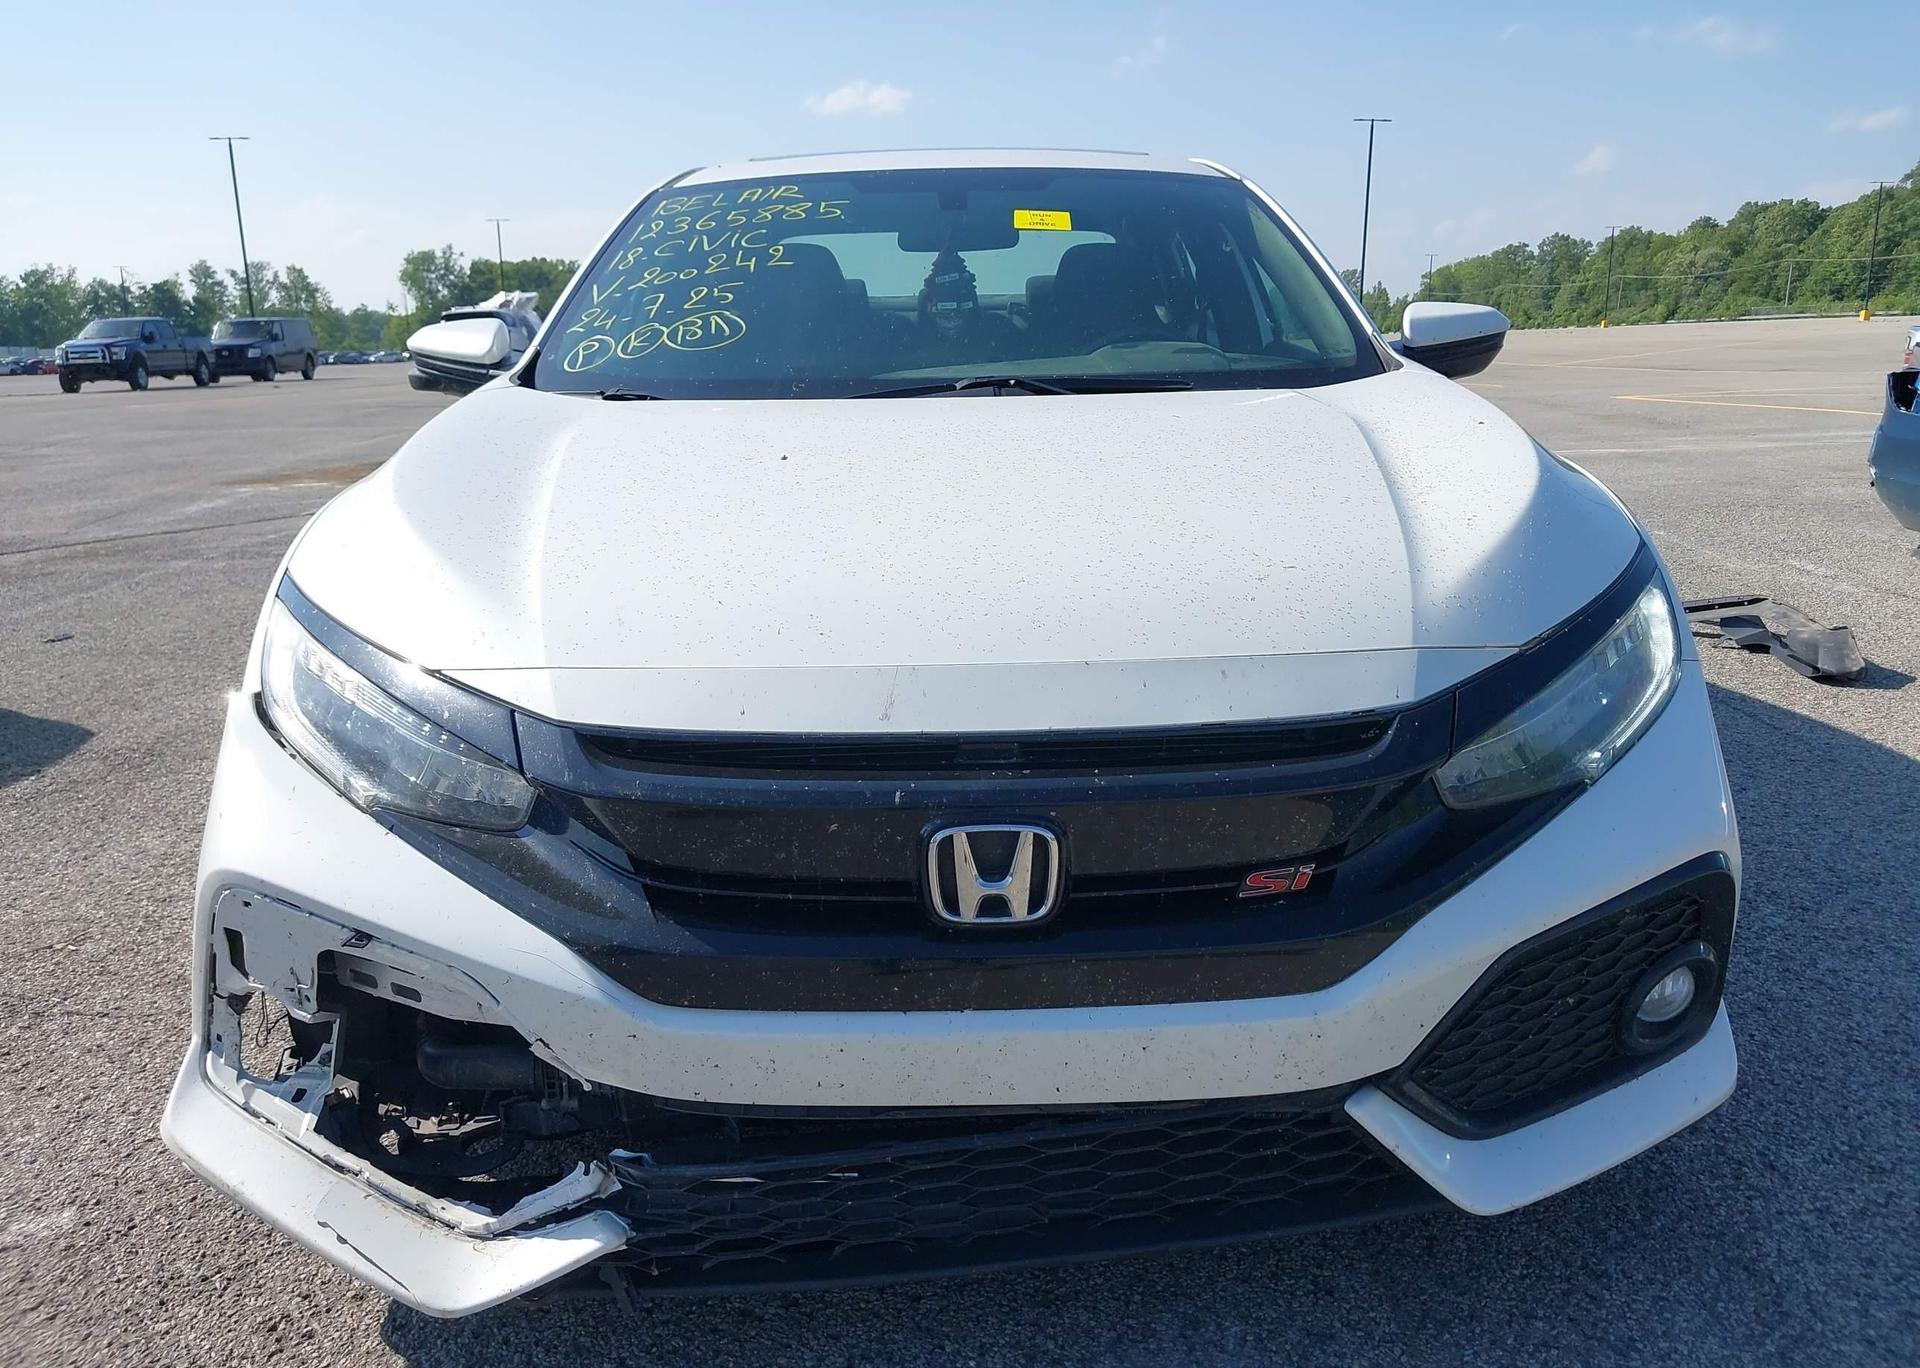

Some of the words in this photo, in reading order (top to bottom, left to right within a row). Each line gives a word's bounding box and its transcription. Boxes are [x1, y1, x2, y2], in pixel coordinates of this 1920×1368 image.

[652, 193, 729, 217] BEL
[737, 186, 804, 203] AIR
[1239, 863, 1316, 898] Si
